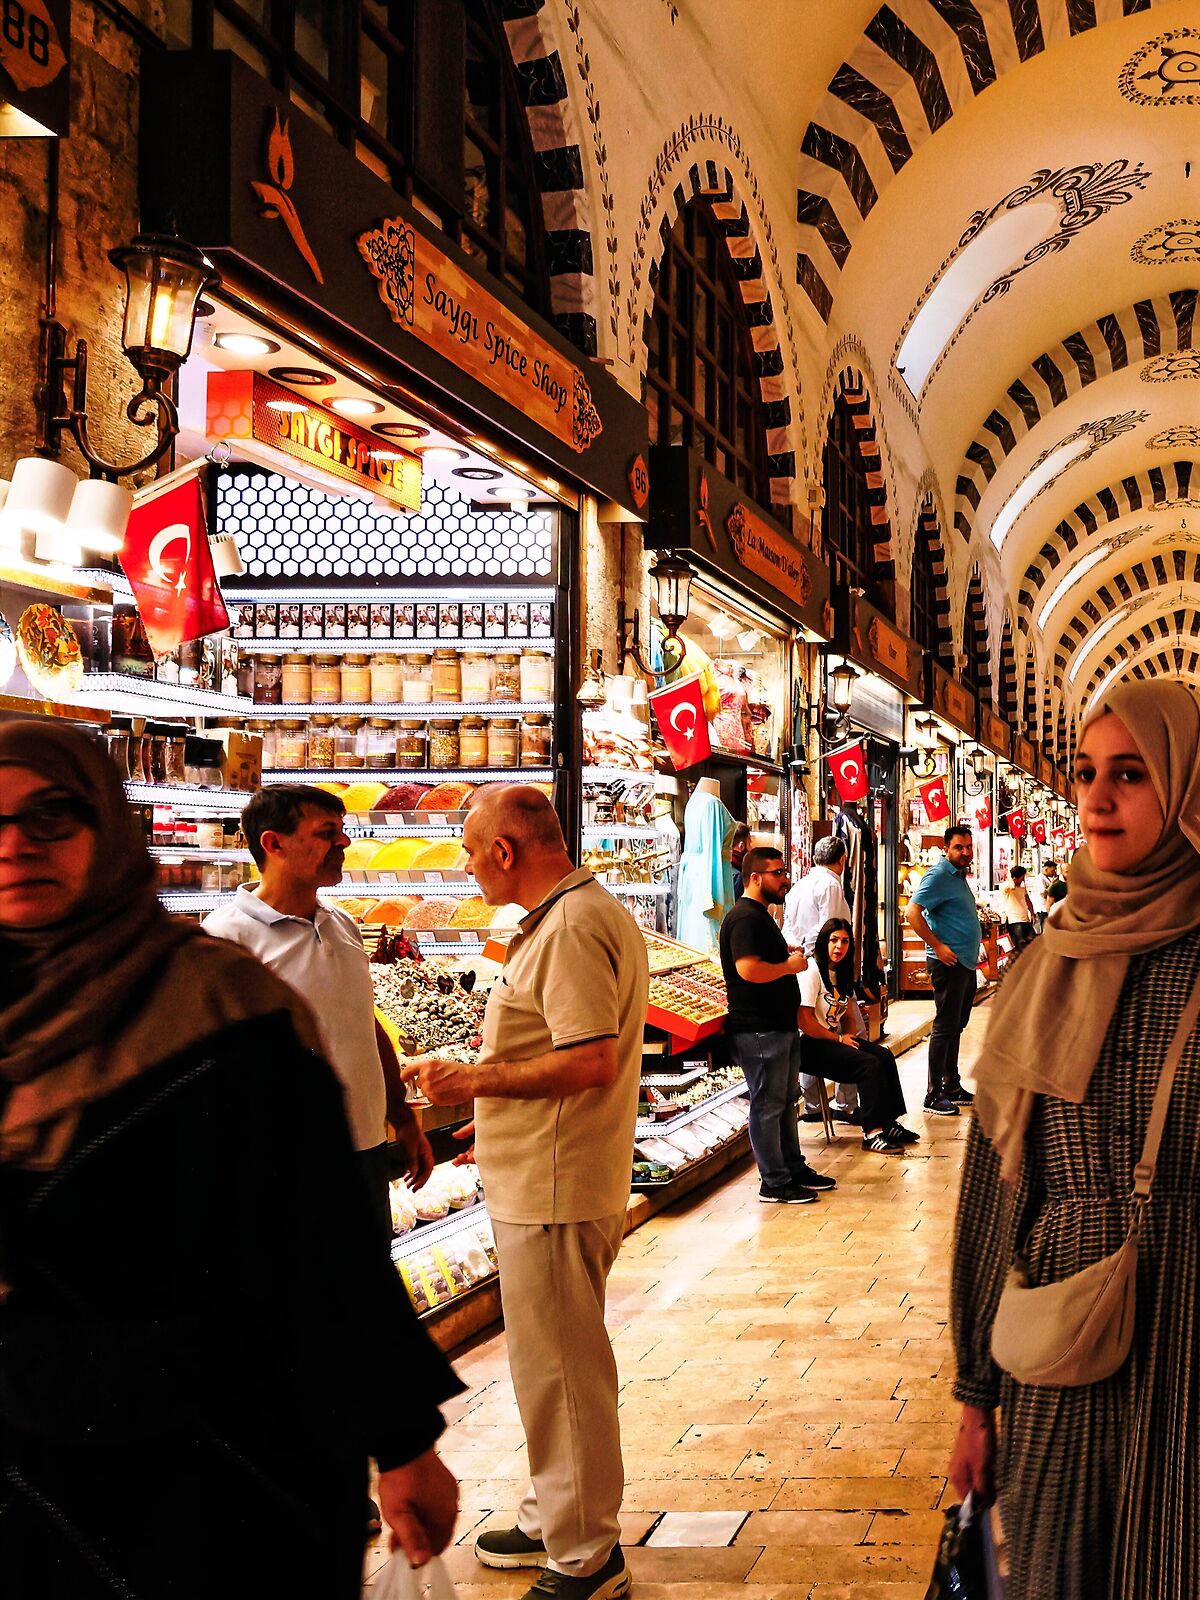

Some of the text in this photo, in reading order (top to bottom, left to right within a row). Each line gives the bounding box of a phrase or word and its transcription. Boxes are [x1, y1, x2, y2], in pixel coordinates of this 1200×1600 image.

[3, 0, 49, 67] 88
[423, 272, 568, 413] Saygı Spice Shop
[346, 437, 404, 492] SPICE
[635, 467, 647, 494] 86
[747, 528, 756, 551] La
